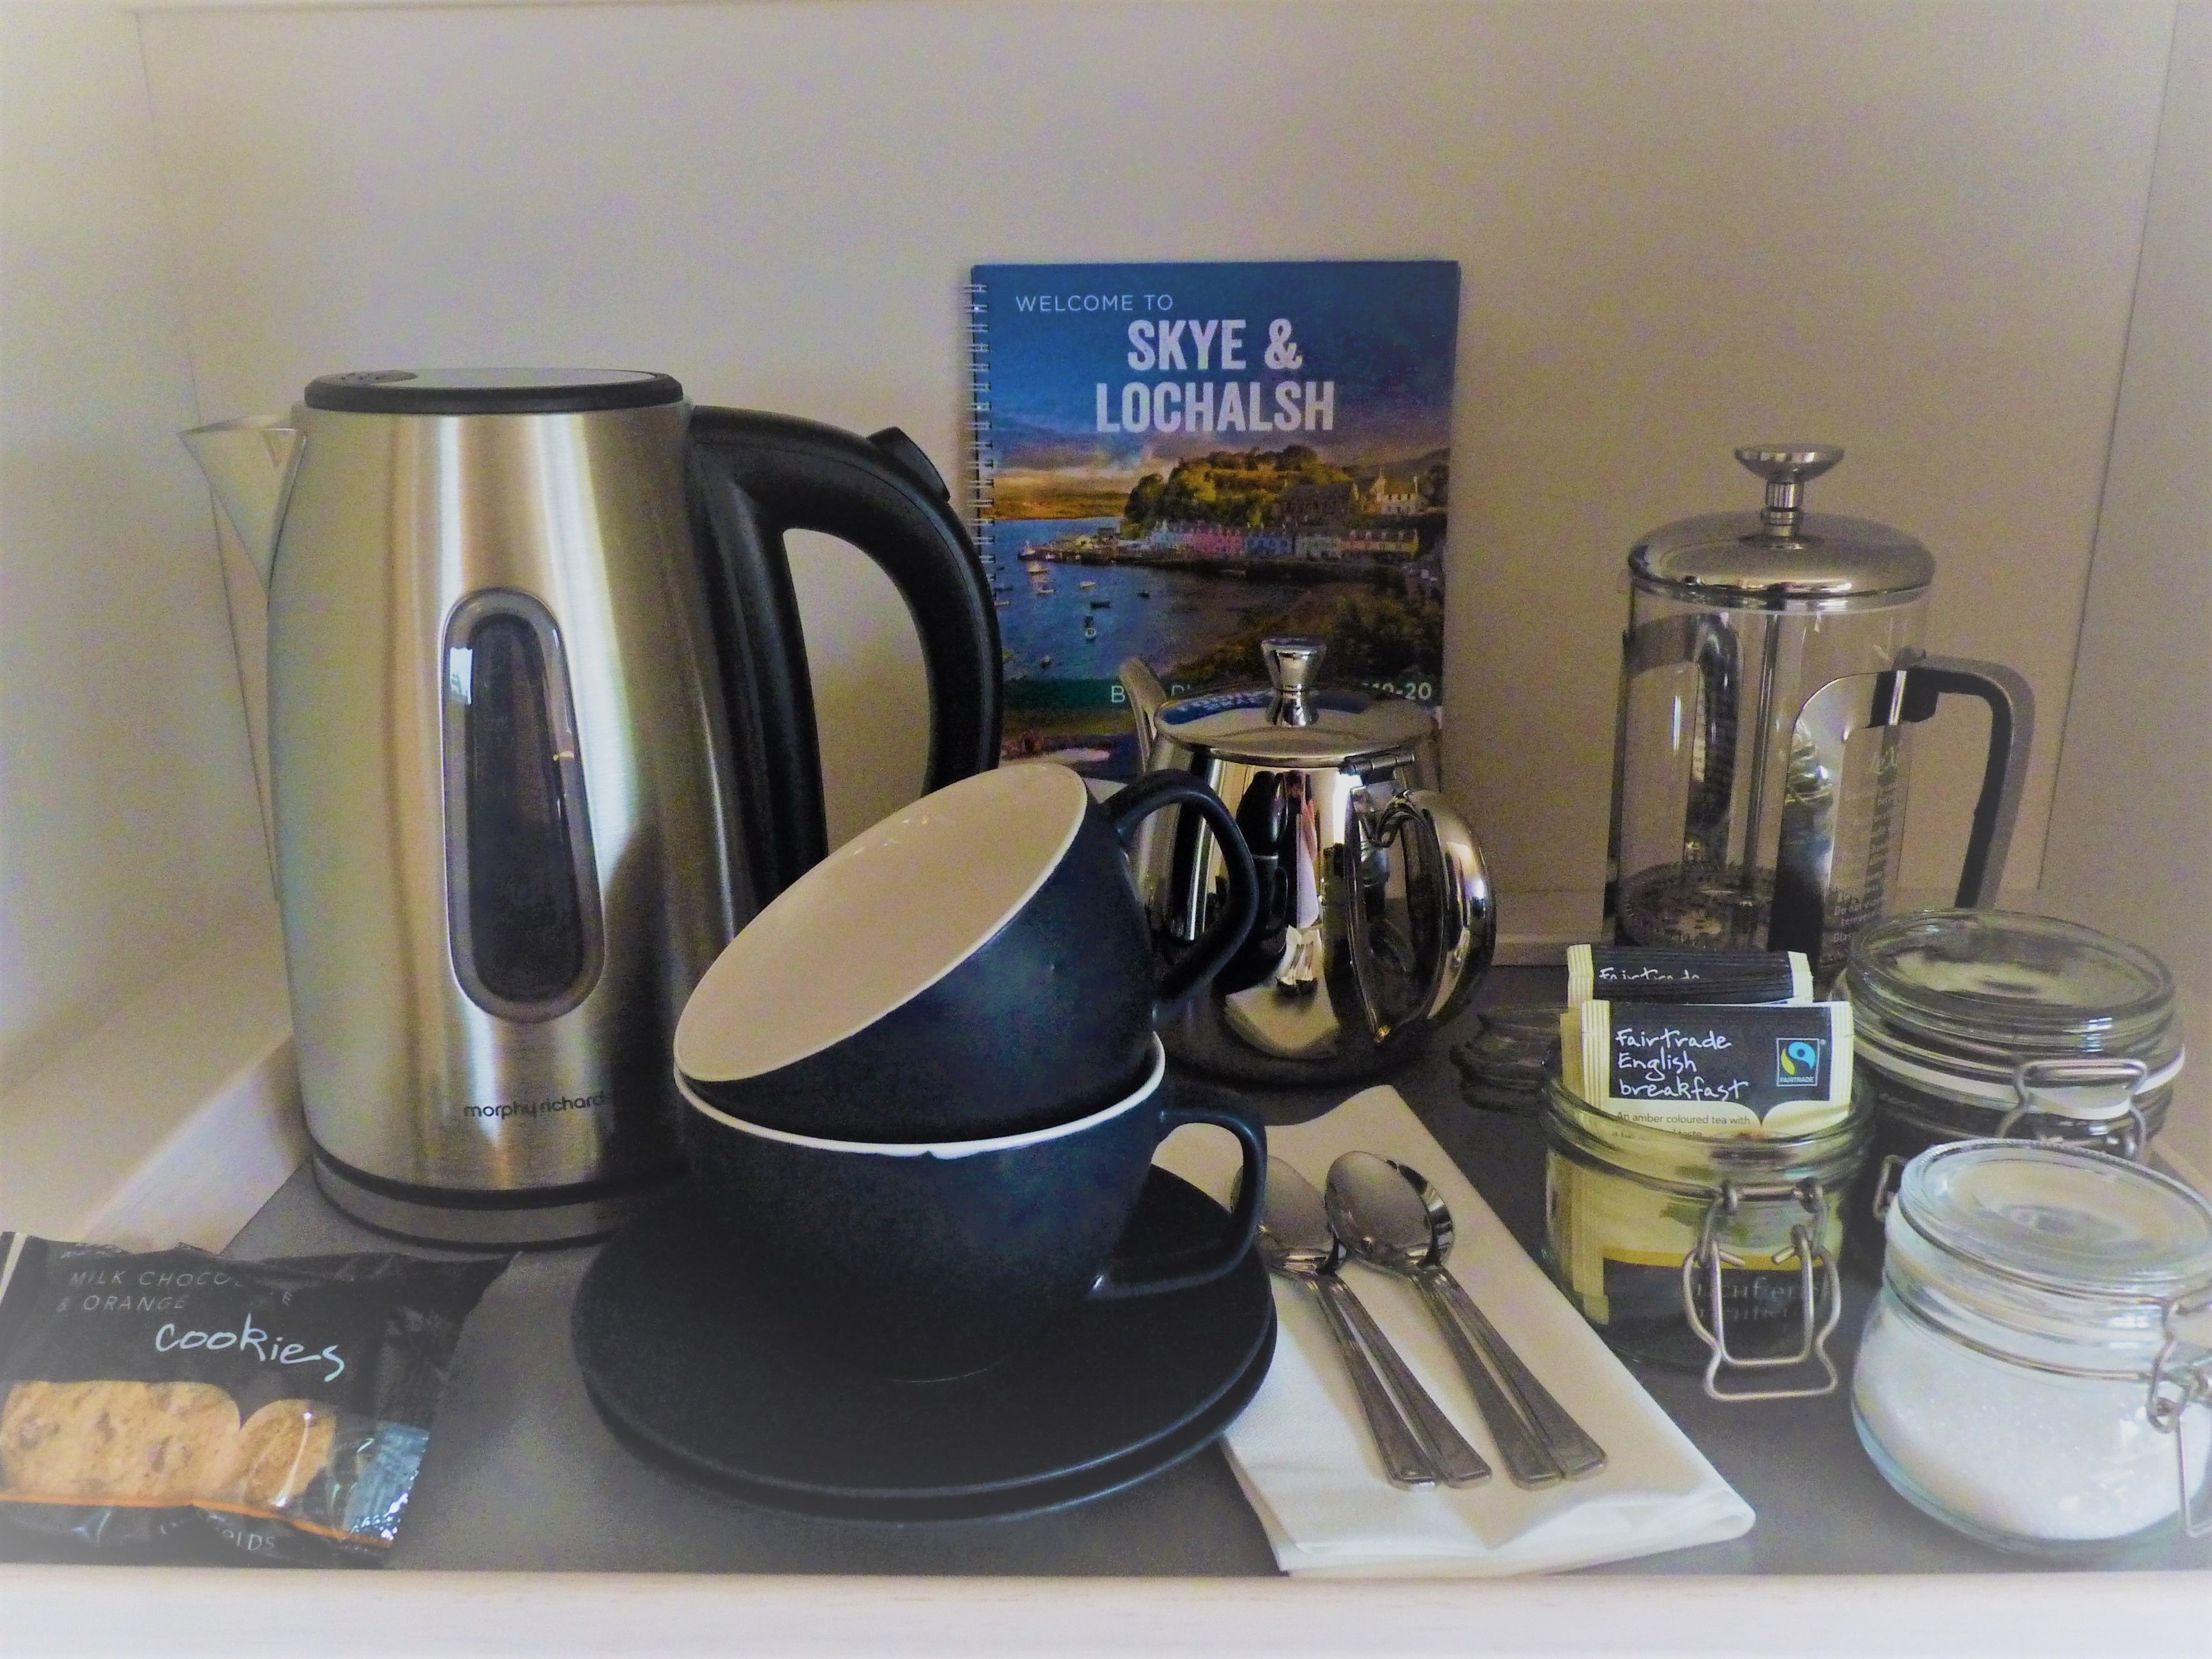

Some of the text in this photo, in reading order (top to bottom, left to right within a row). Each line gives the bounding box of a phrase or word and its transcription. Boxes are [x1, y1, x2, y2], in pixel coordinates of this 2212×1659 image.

[1015, 294, 1173, 313] WELCOME TO
[1127, 319, 1304, 372] SKYE &
[1096, 381, 1335, 434] LOCHALSH
[1615, 1028, 1732, 1050] Fairtrade
[1618, 1047, 1697, 1082] English
[1619, 1075, 1749, 1102] breakfast
[464, 1091, 608, 1119] morphy richard
[1616, 1111, 1629, 1122] An
[1633, 1113, 1663, 1123] amber
[1666, 1115, 1709, 1124] coloured
[1730, 1115, 1751, 1124] with
[70, 1271, 127, 1286] MILK
[83, 1294, 189, 1312] ORANGE
[155, 1314, 346, 1382] cookies
